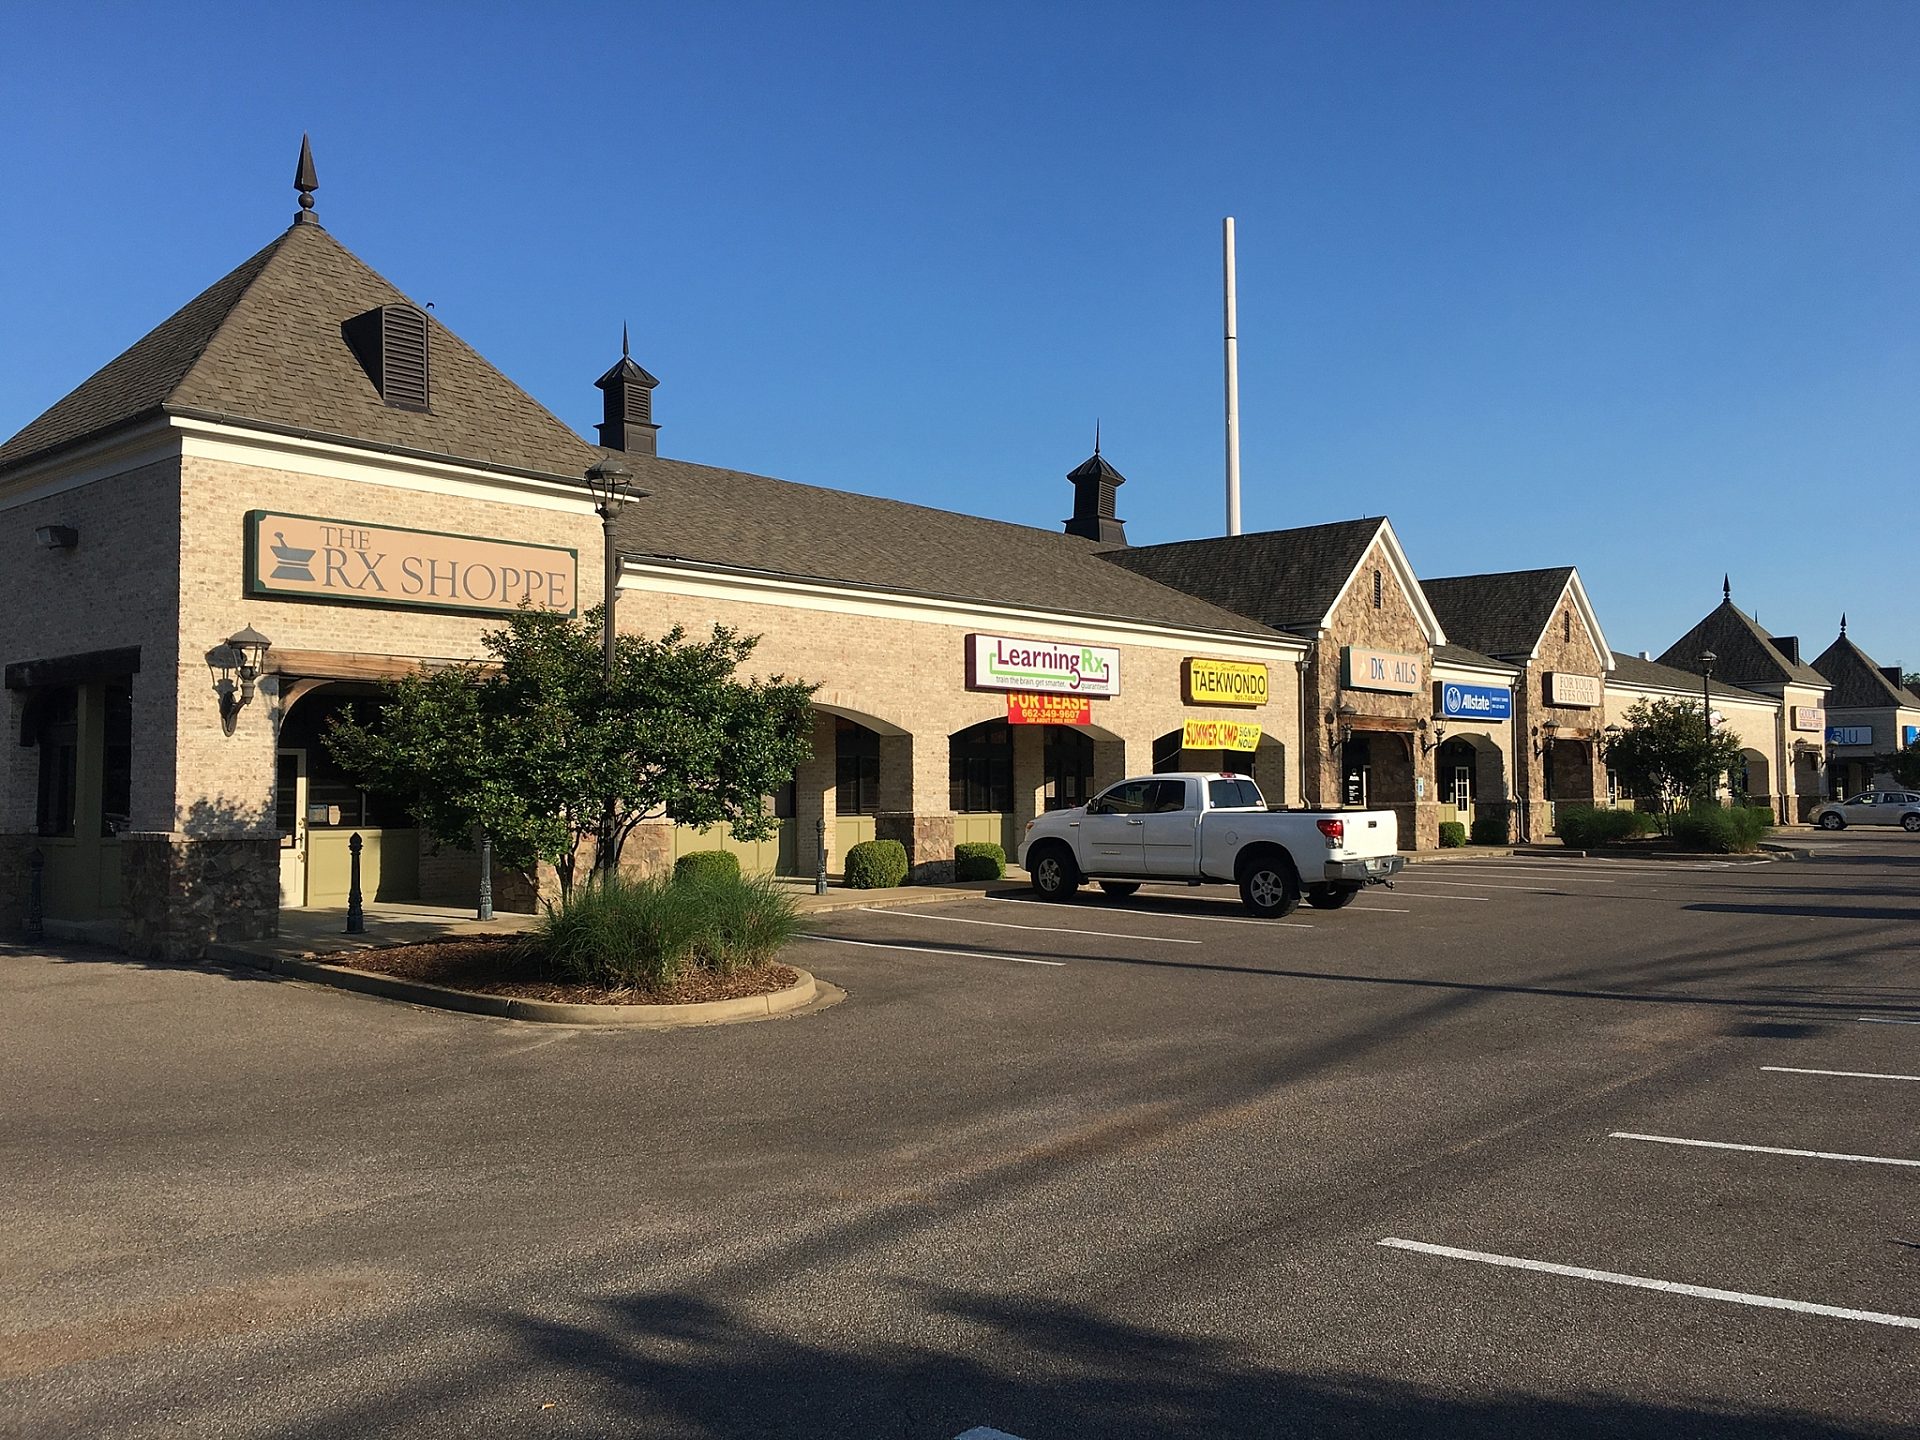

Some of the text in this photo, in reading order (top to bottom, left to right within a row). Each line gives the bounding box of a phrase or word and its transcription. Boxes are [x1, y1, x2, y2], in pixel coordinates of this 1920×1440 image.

[319, 525, 371, 550] THE
[321, 546, 568, 609] RX SHOPPE
[1371, 657, 1385, 680] DK
[1193, 670, 1266, 694] TAEKWONDO
[1560, 677, 1594, 691] FOR YOUR
[1009, 692, 1089, 711] FOR LEASE
[1461, 693, 1490, 711] Allstate
[1559, 689, 1595, 703] EYES ONLY
[1021, 708, 1080, 719] 662-349-9607
